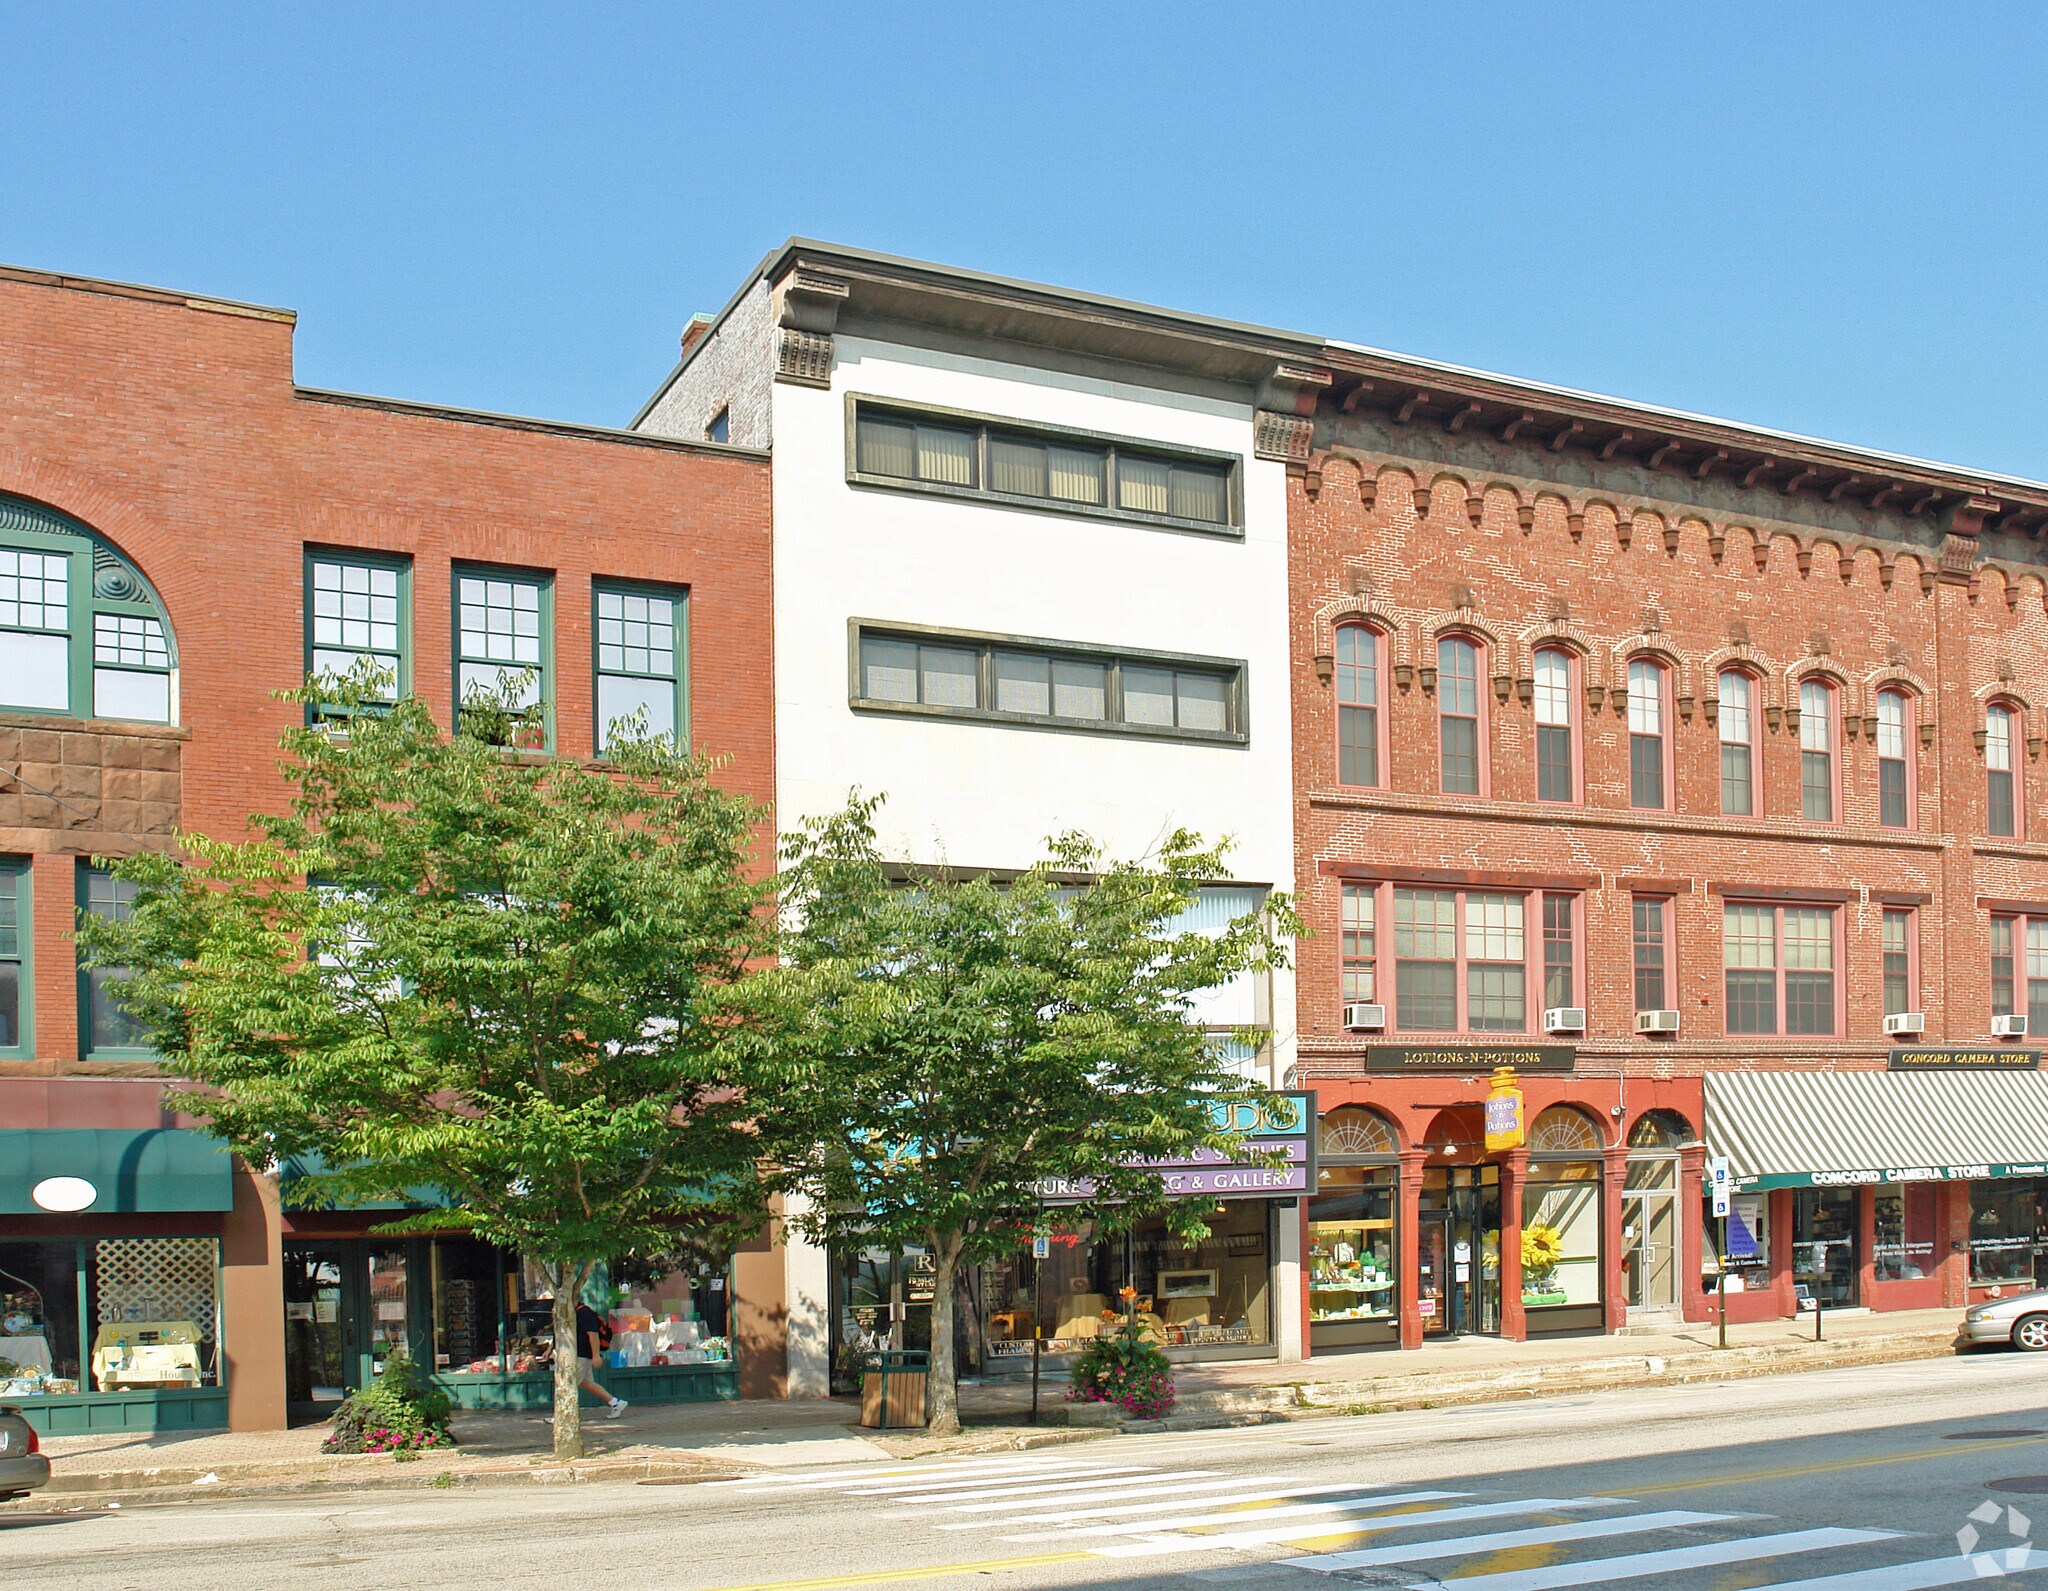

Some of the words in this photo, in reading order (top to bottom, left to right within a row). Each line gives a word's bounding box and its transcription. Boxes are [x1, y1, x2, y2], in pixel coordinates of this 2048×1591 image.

[1403, 1052, 1541, 1064] LOTIONS-N-POTIONS
[1902, 1054, 1951, 1064] CONCORD
[1954, 1054, 1995, 1064] CAMERA
[1999, 1054, 2030, 1063] STORE
[1487, 1120, 1516, 1131] Potions
[1191, 1175, 1204, 1189] &
[1213, 1171, 1295, 1189] GALLERY
[1736, 1176, 1759, 1185] CAMERA
[1811, 1169, 1882, 1185] CONCORD
[1885, 1166, 1944, 1182] CAMERA
[1948, 1164, 1991, 1179] STORE
[2005, 1165, 2011, 1174] A
[918, 1255, 936, 1273] R
